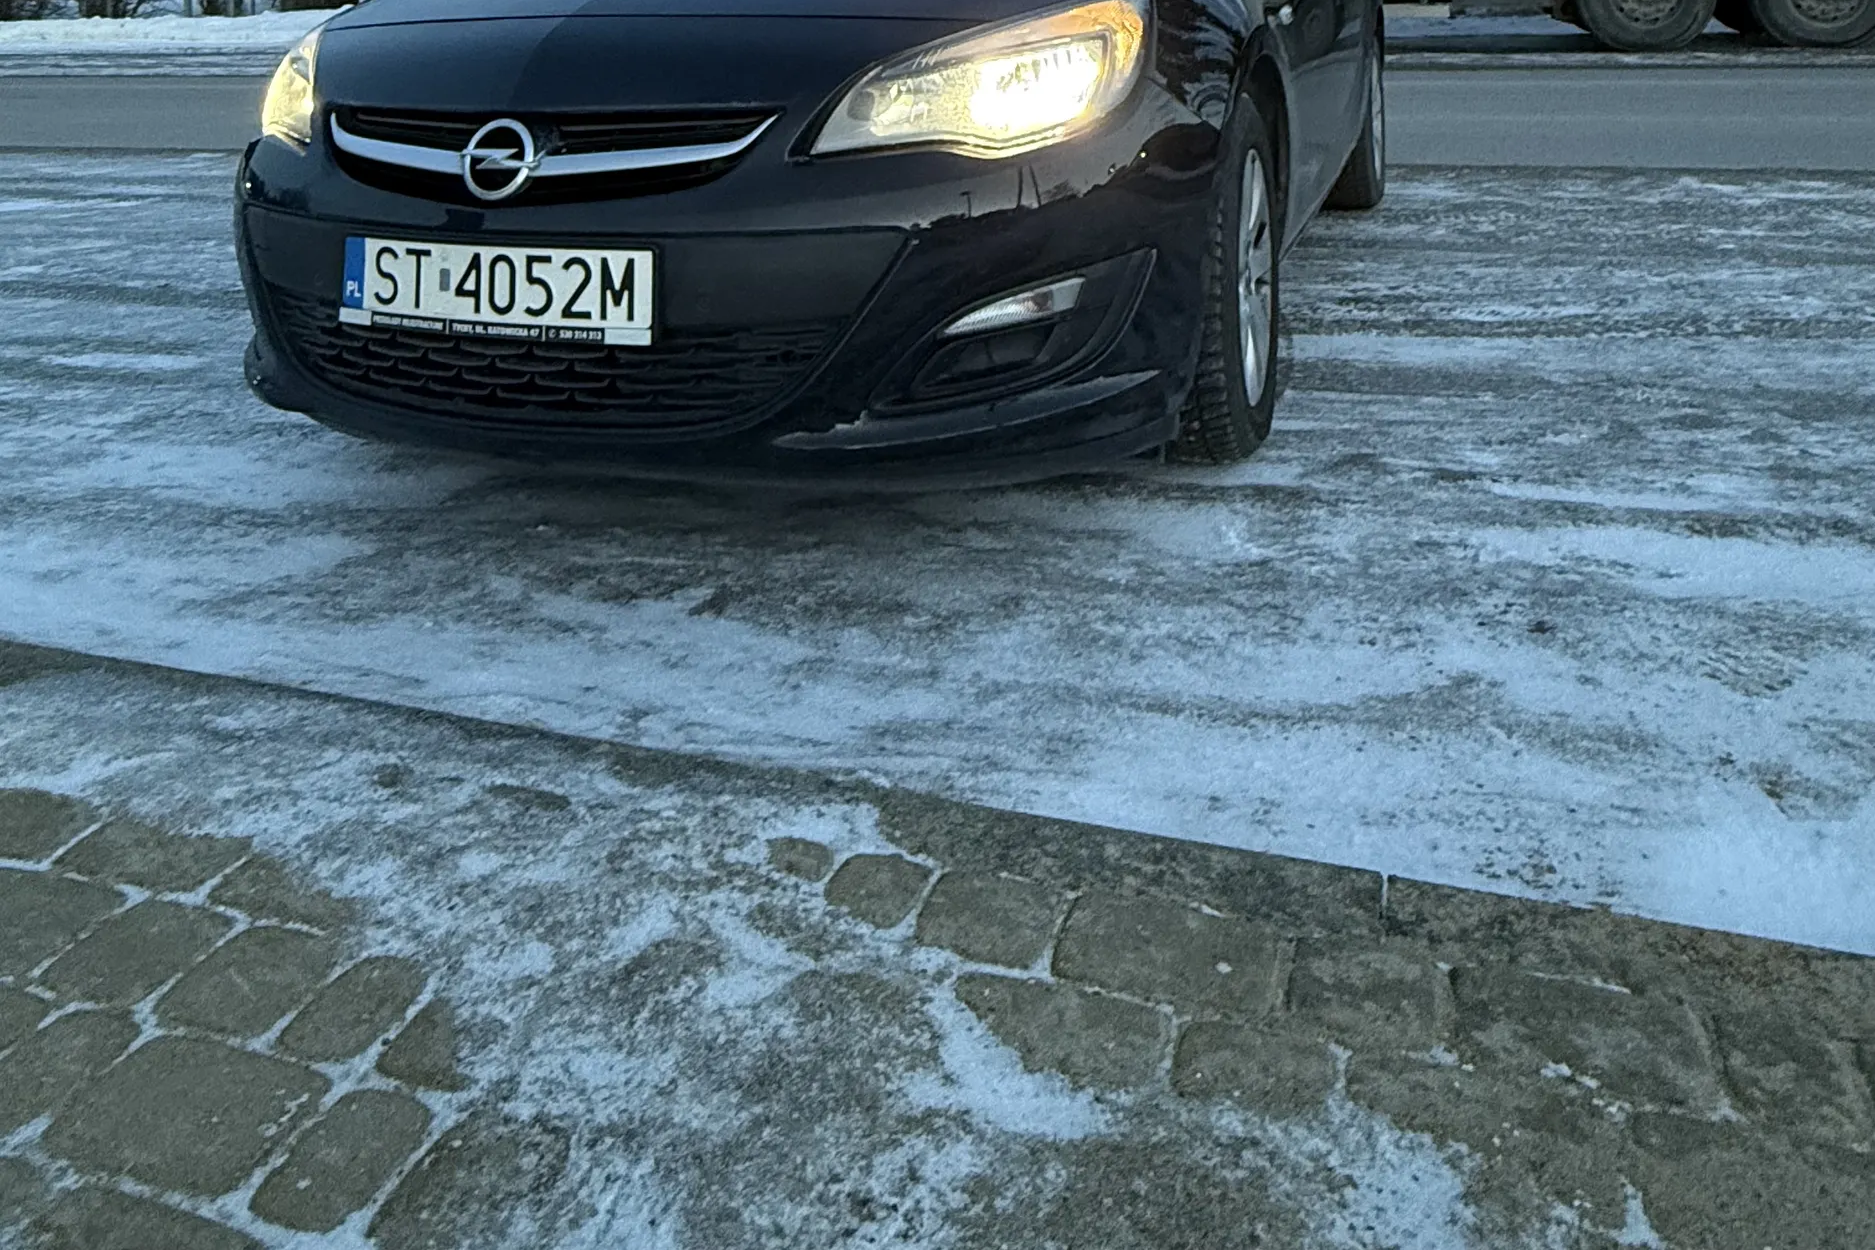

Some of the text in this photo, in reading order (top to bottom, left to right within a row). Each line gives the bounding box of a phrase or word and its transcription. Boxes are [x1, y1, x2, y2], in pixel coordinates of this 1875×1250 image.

[346, 280, 362, 299] PL
[374, 246, 635, 322] ST 4052M
